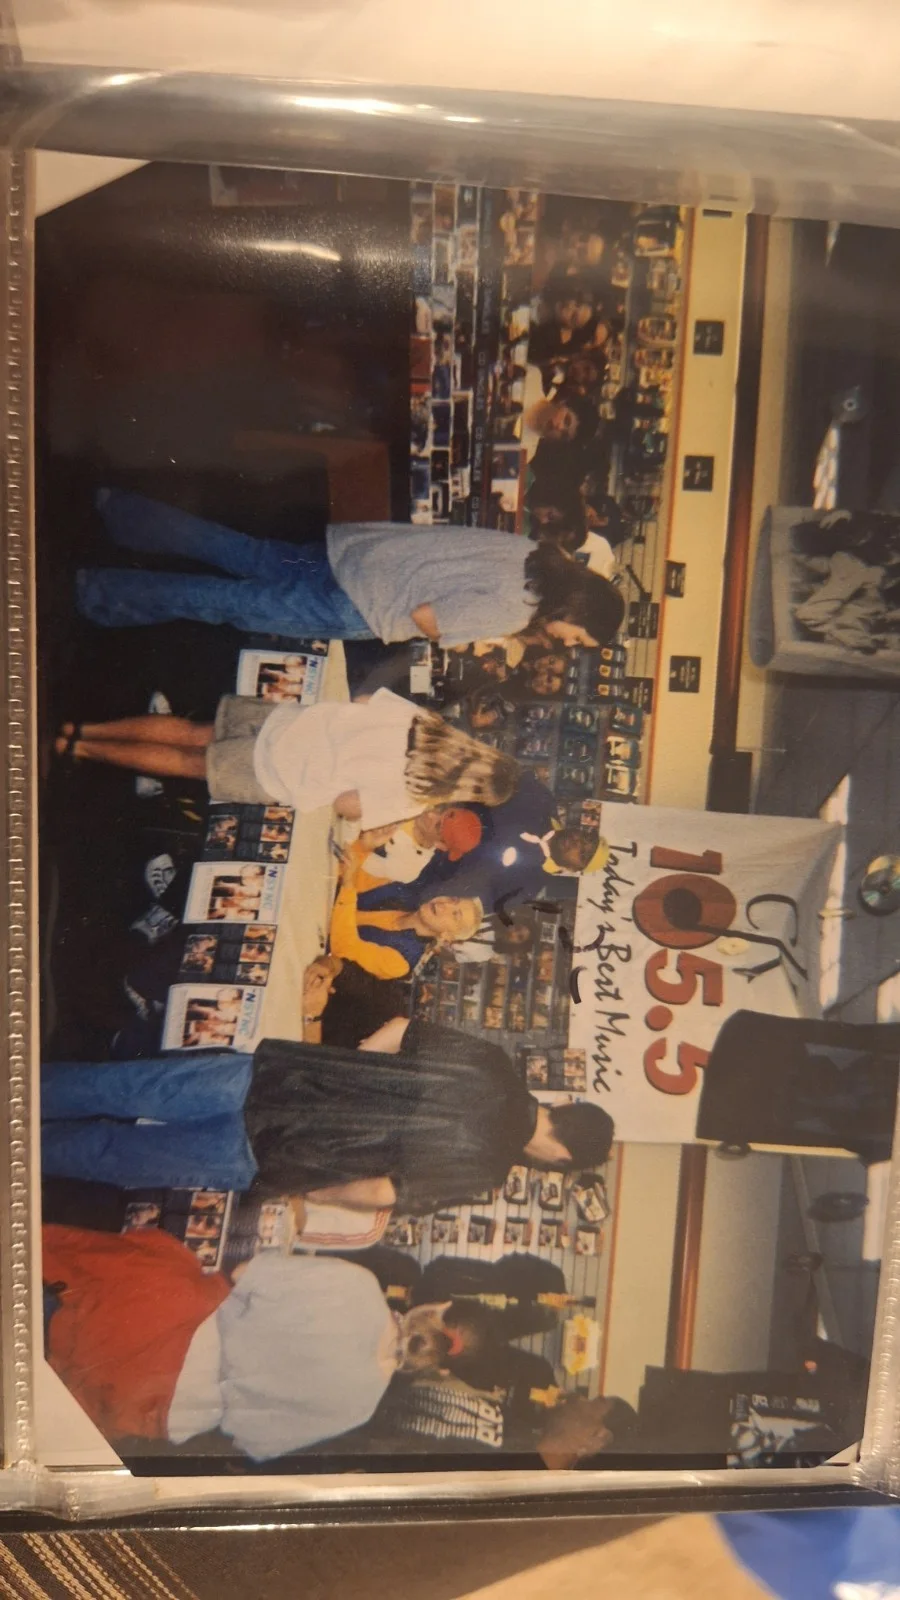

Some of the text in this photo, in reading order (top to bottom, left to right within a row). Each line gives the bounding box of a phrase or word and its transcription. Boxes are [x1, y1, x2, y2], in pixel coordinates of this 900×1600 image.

[589, 841, 637, 1094] Today's Best Music
[632, 845, 737, 1096] 105.5
